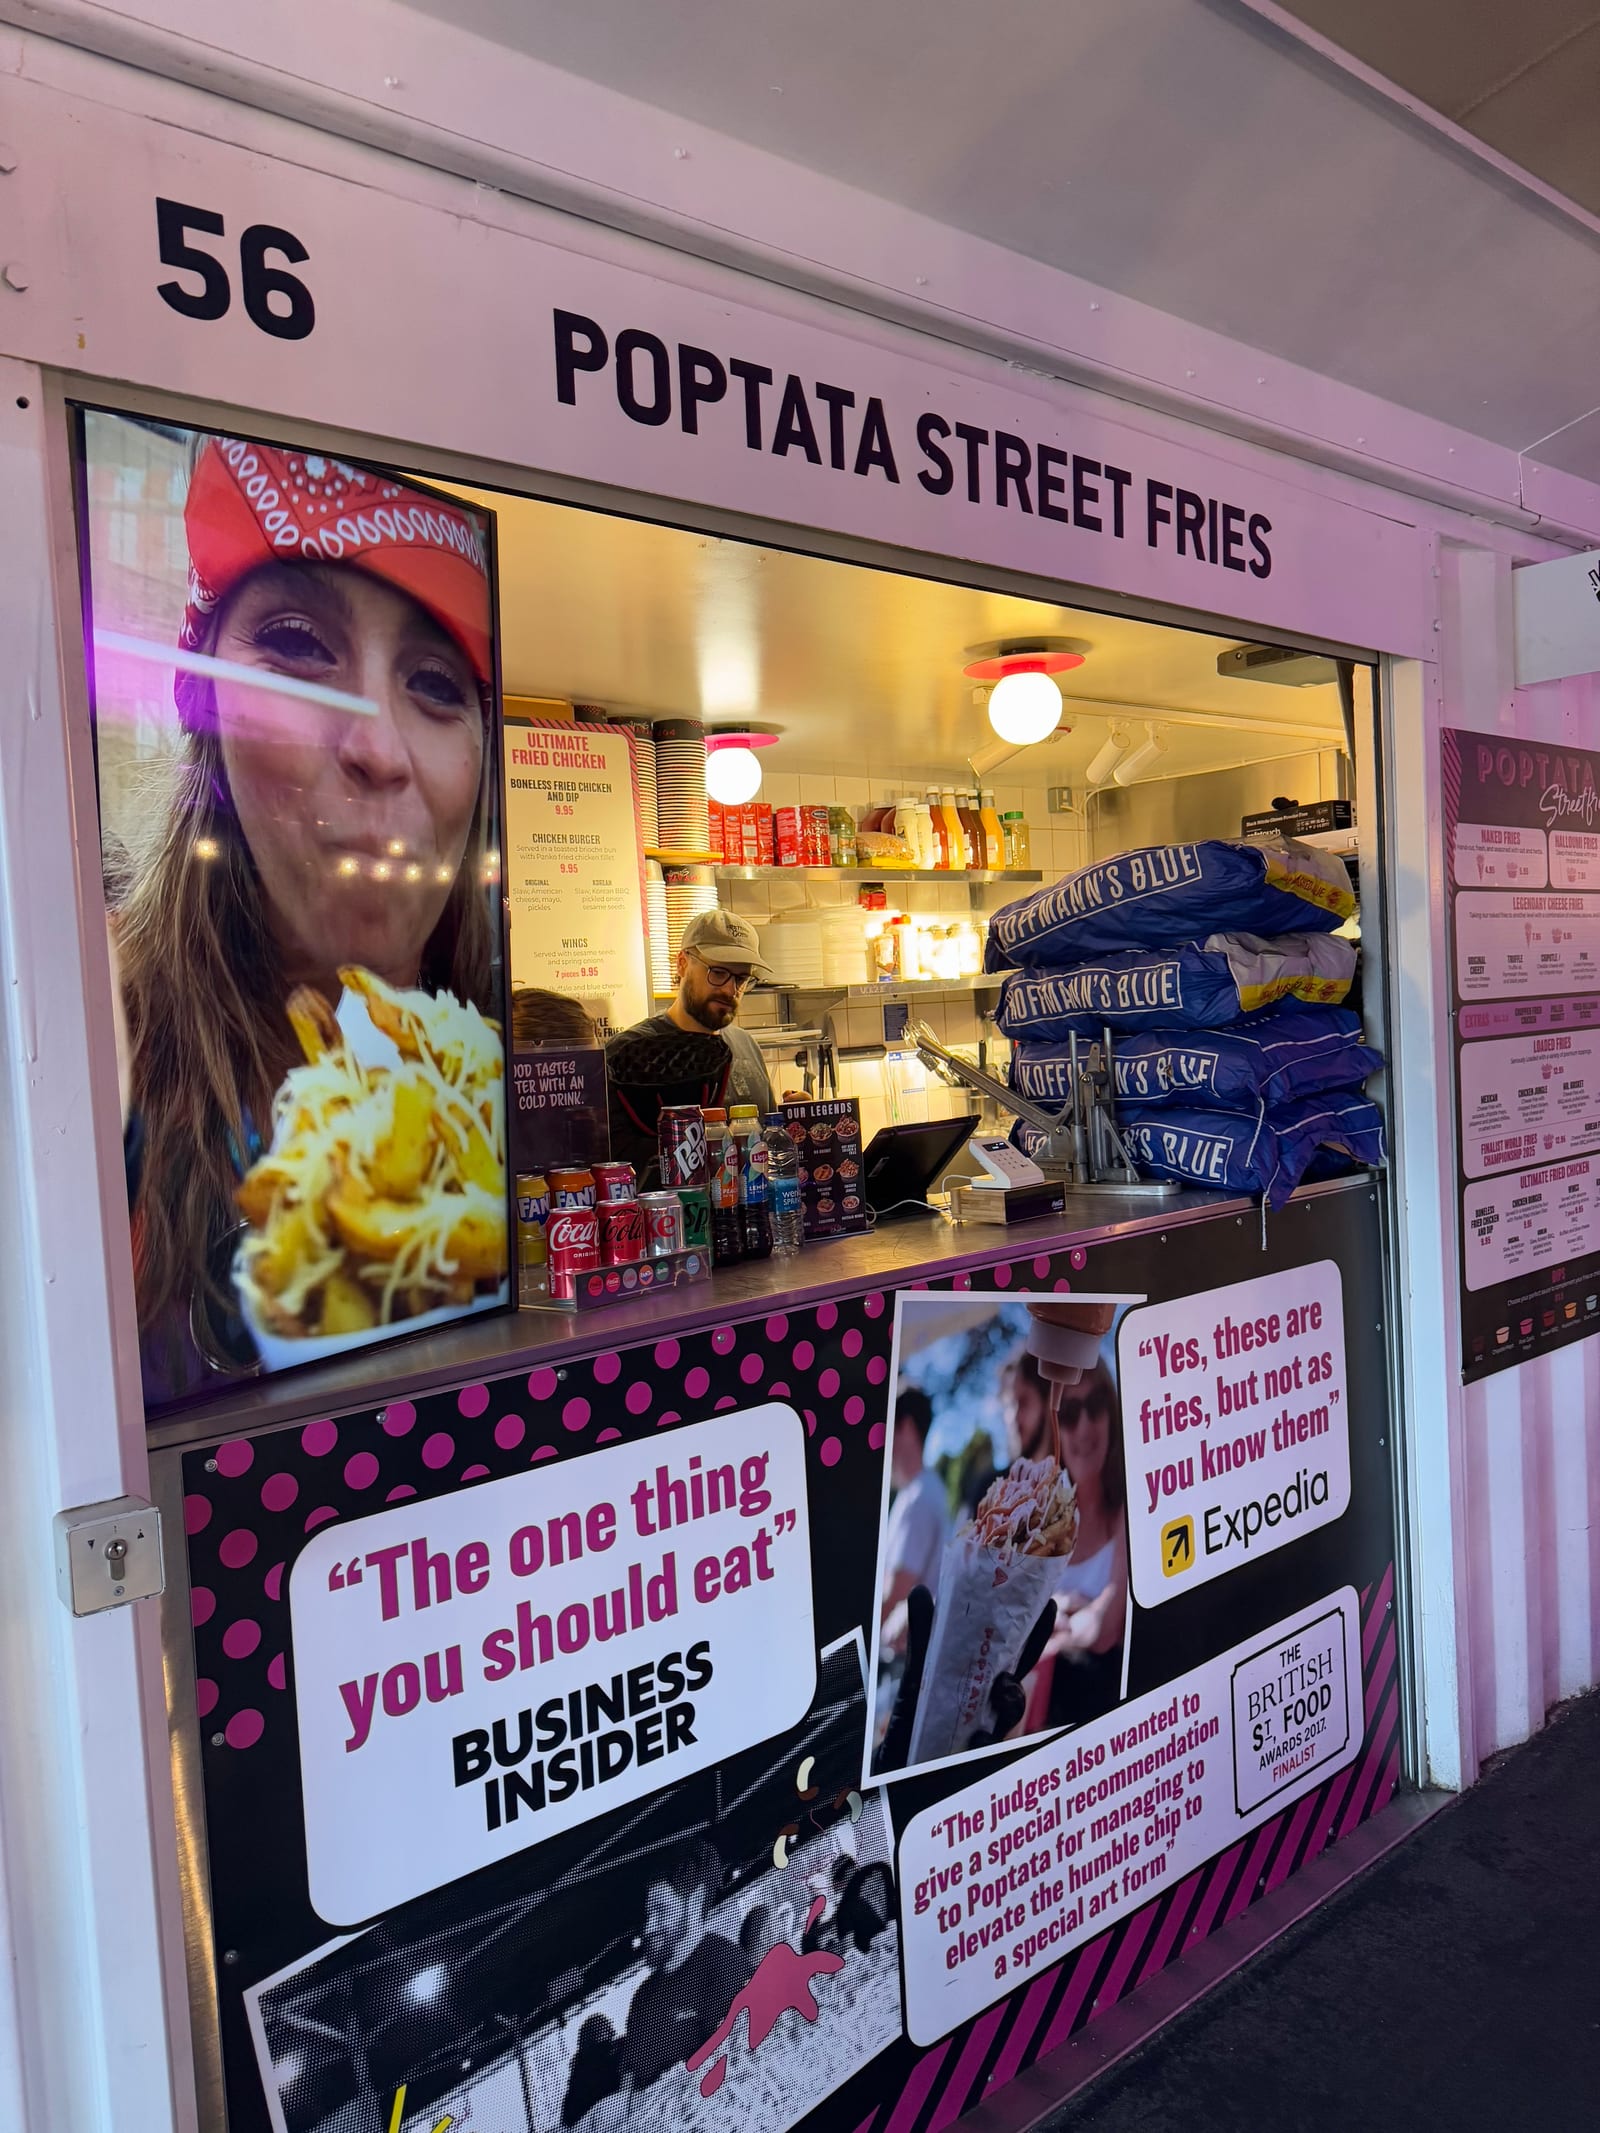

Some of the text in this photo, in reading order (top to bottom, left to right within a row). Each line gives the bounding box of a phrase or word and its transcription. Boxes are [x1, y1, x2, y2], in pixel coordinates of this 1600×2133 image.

[156, 197, 315, 340] 56
[553, 308, 1272, 579] POPTATA STREET FRIES
[512, 749, 606, 769] FRIED CHICKEN
[527, 732, 589, 751] ULTIMATE
[510, 778, 612, 793] BONELESS FRIED CHICKEN
[1477, 744, 1596, 794] POPTATA
[547, 791, 579, 802] AND DIP
[555, 804, 574, 815] 9.95
[532, 833, 600, 845] CHICKEN BURGER
[554, 845, 578, 853] toasted
[1481, 829, 1521, 845] NAKED FRIES
[560, 863, 579, 873] 9.95
[1131, 846, 1196, 891] BLUE
[1513, 896, 1547, 910] LEGENDARY
[1548, 897, 1568, 911] CHEESE
[561, 938, 588, 948] WINGS
[581, 966, 598, 977] 9.95
[1117, 968, 1176, 1008] BLUE
[1533, 1036, 1571, 1053] LOADED FRIES
[535, 1061, 576, 1076] TASTES
[539, 1076, 566, 1092] WITH
[569, 1075, 584, 1090] AN
[1157, 1054, 1211, 1090] BLUE
[519, 1091, 585, 1110] COLD DRINK.
[787, 1102, 852, 1119] OUR LEGENDS
[1163, 1132, 1227, 1178] BLUE
[1481, 1133, 1538, 1155] FINALIST WORLD FRIES
[1484, 1148, 1521, 1167] CHAMPIONSHIP
[1520, 1160, 1590, 1189] ULTIMATE FRIED CHICKEN
[1139, 1301, 1322, 1378] “Yes, these are
[1139, 1351, 1332, 1444] fries, but not as
[1145, 1389, 1340, 1514] you know them”
[1204, 1468, 1329, 1555] Expedia
[329, 1451, 772, 1621] “The one thing
[338, 1509, 797, 1753] you should eat”
[1279, 1643, 1302, 1668] THE
[1248, 1648, 1334, 1721] BRITISH
[452, 1641, 714, 1787] BUSINESS
[1284, 1683, 1331, 1733] FOOD
[485, 1701, 698, 1831] INSIDER
[931, 1693, 1200, 1848] “The judges also wanted to
[1259, 1732, 1302, 1771] AWARDS
[1272, 1743, 1316, 1783] FINALIST
[914, 1716, 1219, 1915] give a special recommendation
[937, 1759, 1205, 1934] to Poptata for managing to
[946, 1795, 1202, 1970] elevate the humble chip to
[994, 1838, 1175, 1980] a special art form”
